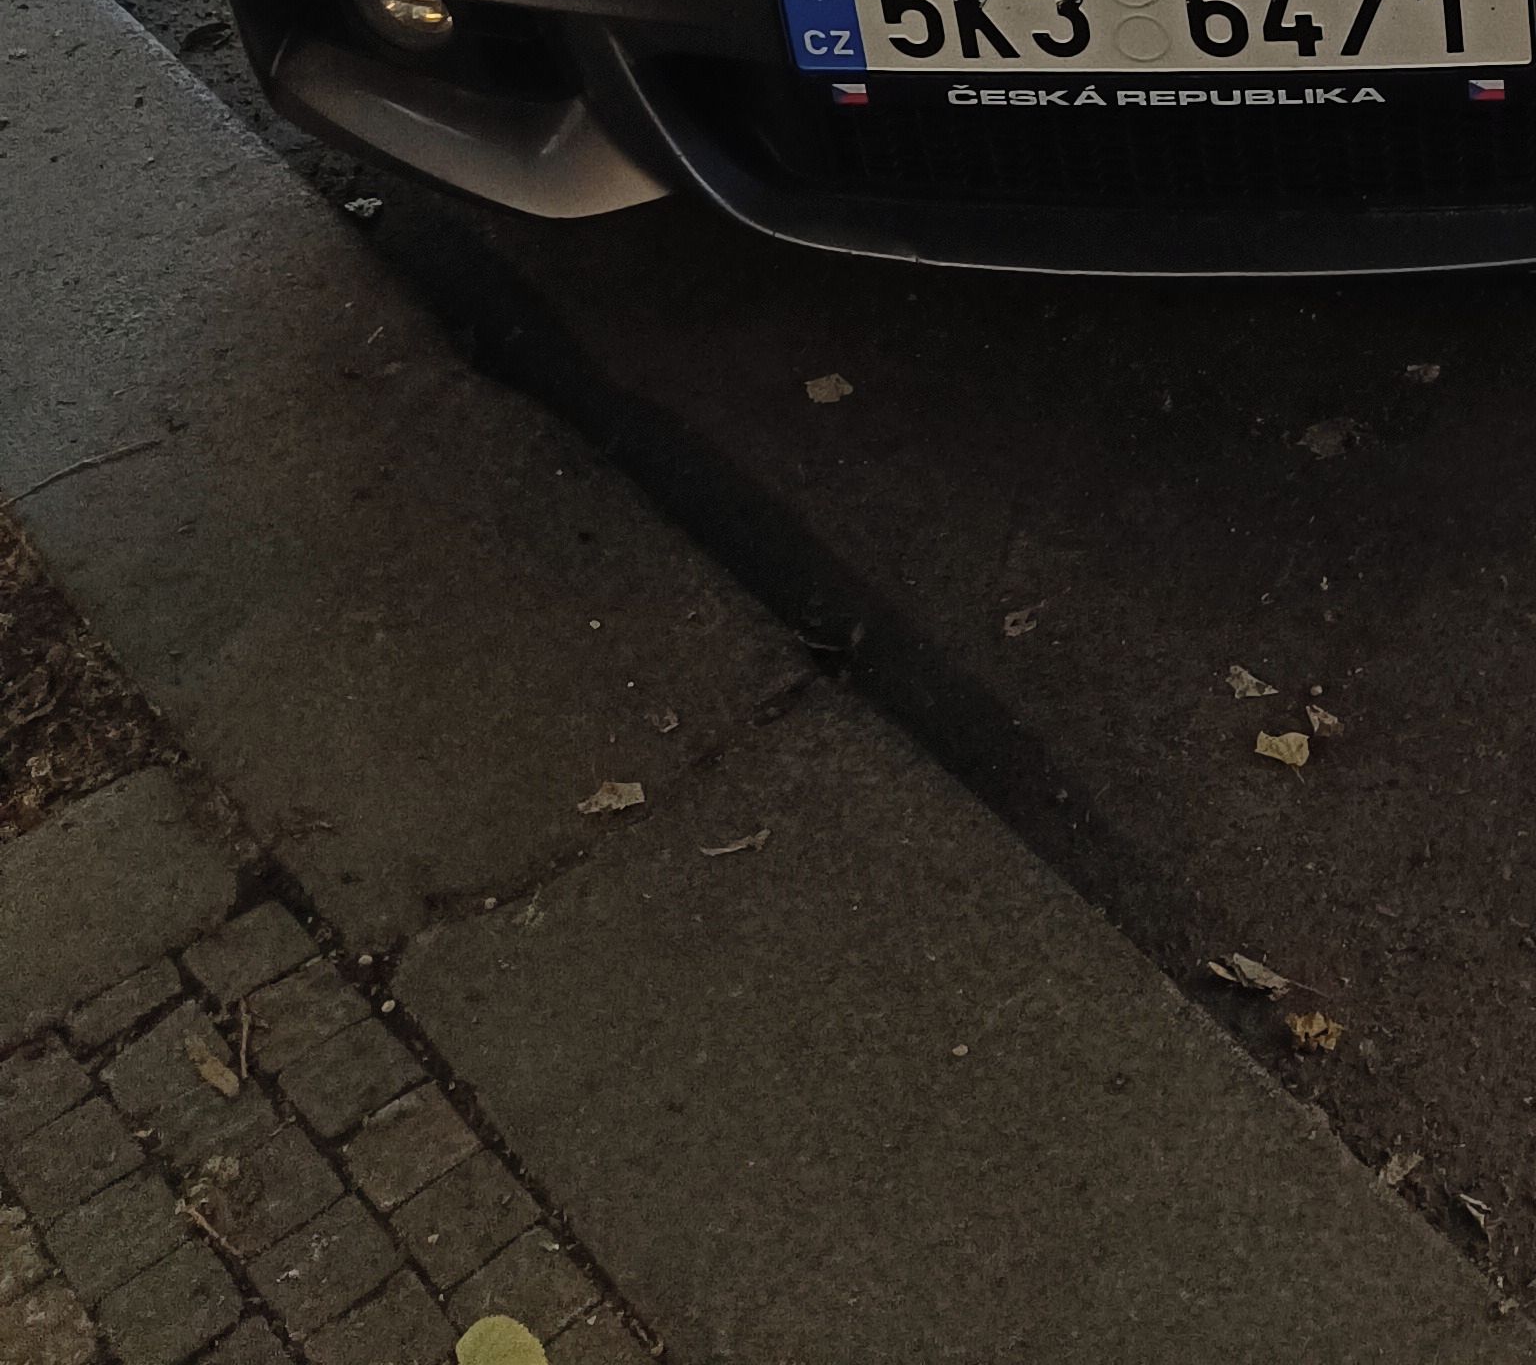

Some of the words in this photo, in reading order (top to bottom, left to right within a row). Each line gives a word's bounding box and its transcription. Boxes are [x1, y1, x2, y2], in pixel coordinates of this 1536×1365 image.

[803, 29, 854, 56] CZ
[947, 84, 1108, 107] ČESKÁ
[1116, 87, 1386, 107] REPUBLIKA
